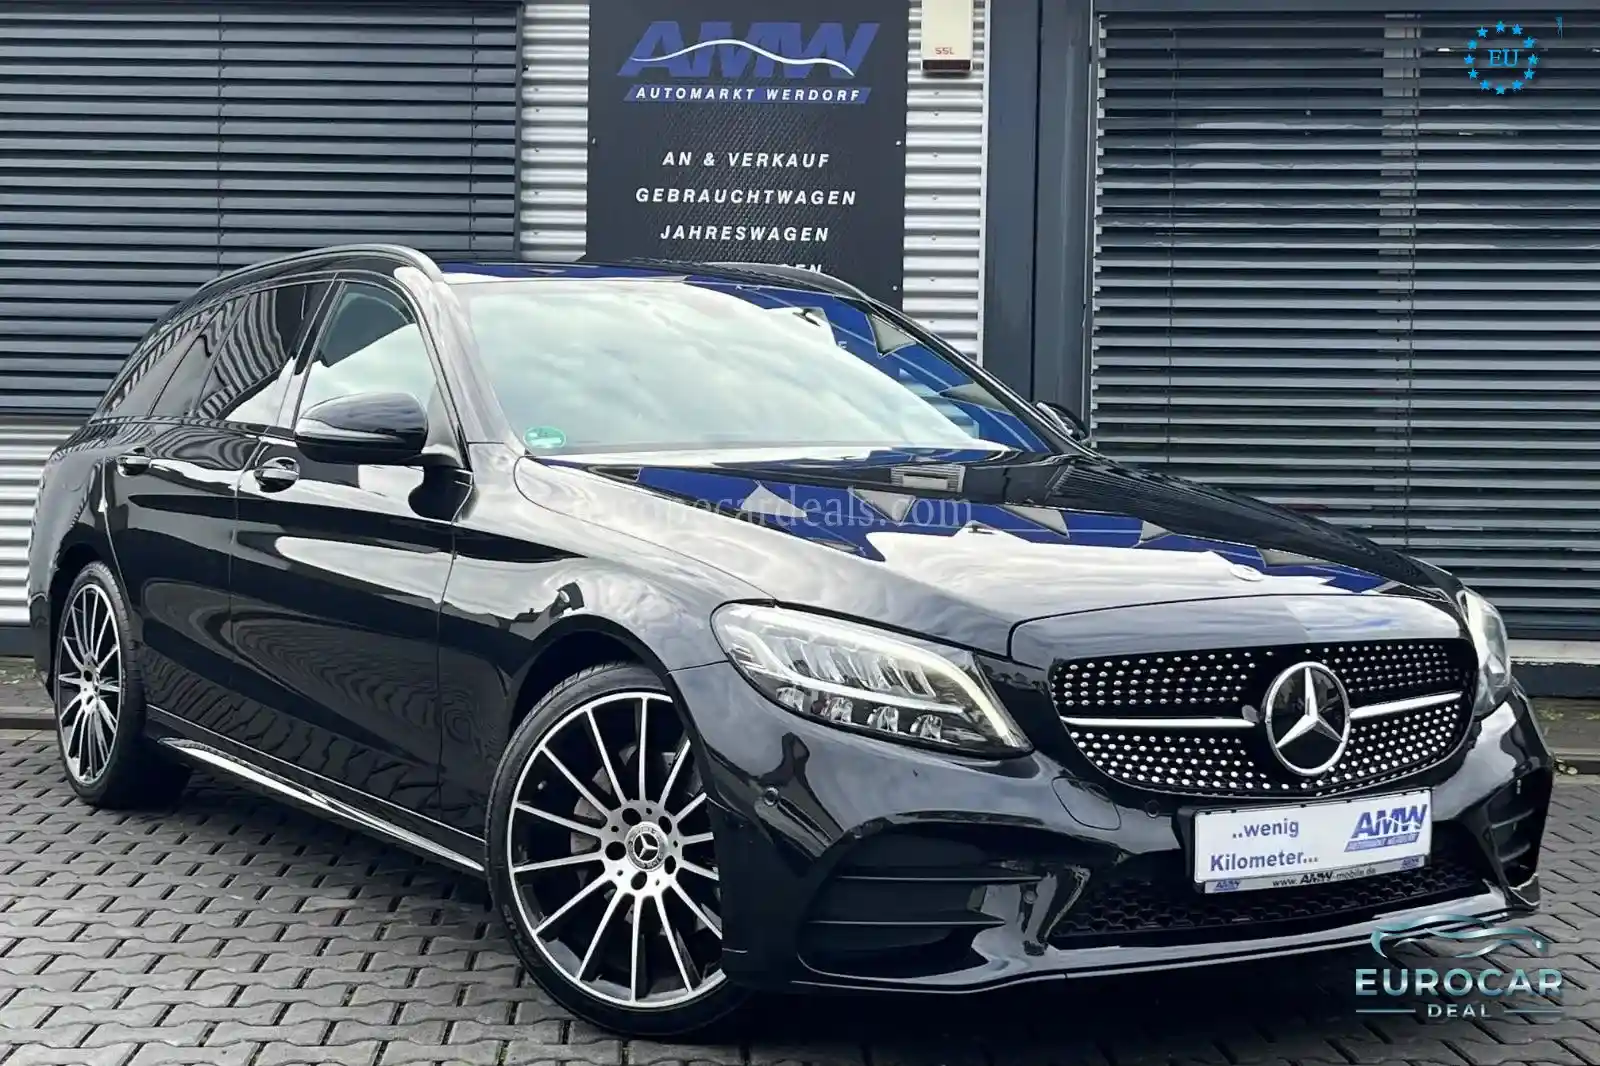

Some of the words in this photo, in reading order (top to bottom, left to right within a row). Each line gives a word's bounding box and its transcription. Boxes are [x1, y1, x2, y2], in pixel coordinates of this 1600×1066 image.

[617, 21, 881, 78] AMW
[636, 86, 755, 100] AUTOMARKT
[767, 88, 861, 102] WERDORF
[663, 152, 692, 166] AN
[703, 152, 716, 166] &
[728, 153, 831, 168] VERKAUF
[636, 188, 857, 206] GEBRAUCHTWAGEN
[660, 226, 829, 242] JAHRESWAGEN
[1351, 804, 1428, 839] AMW
